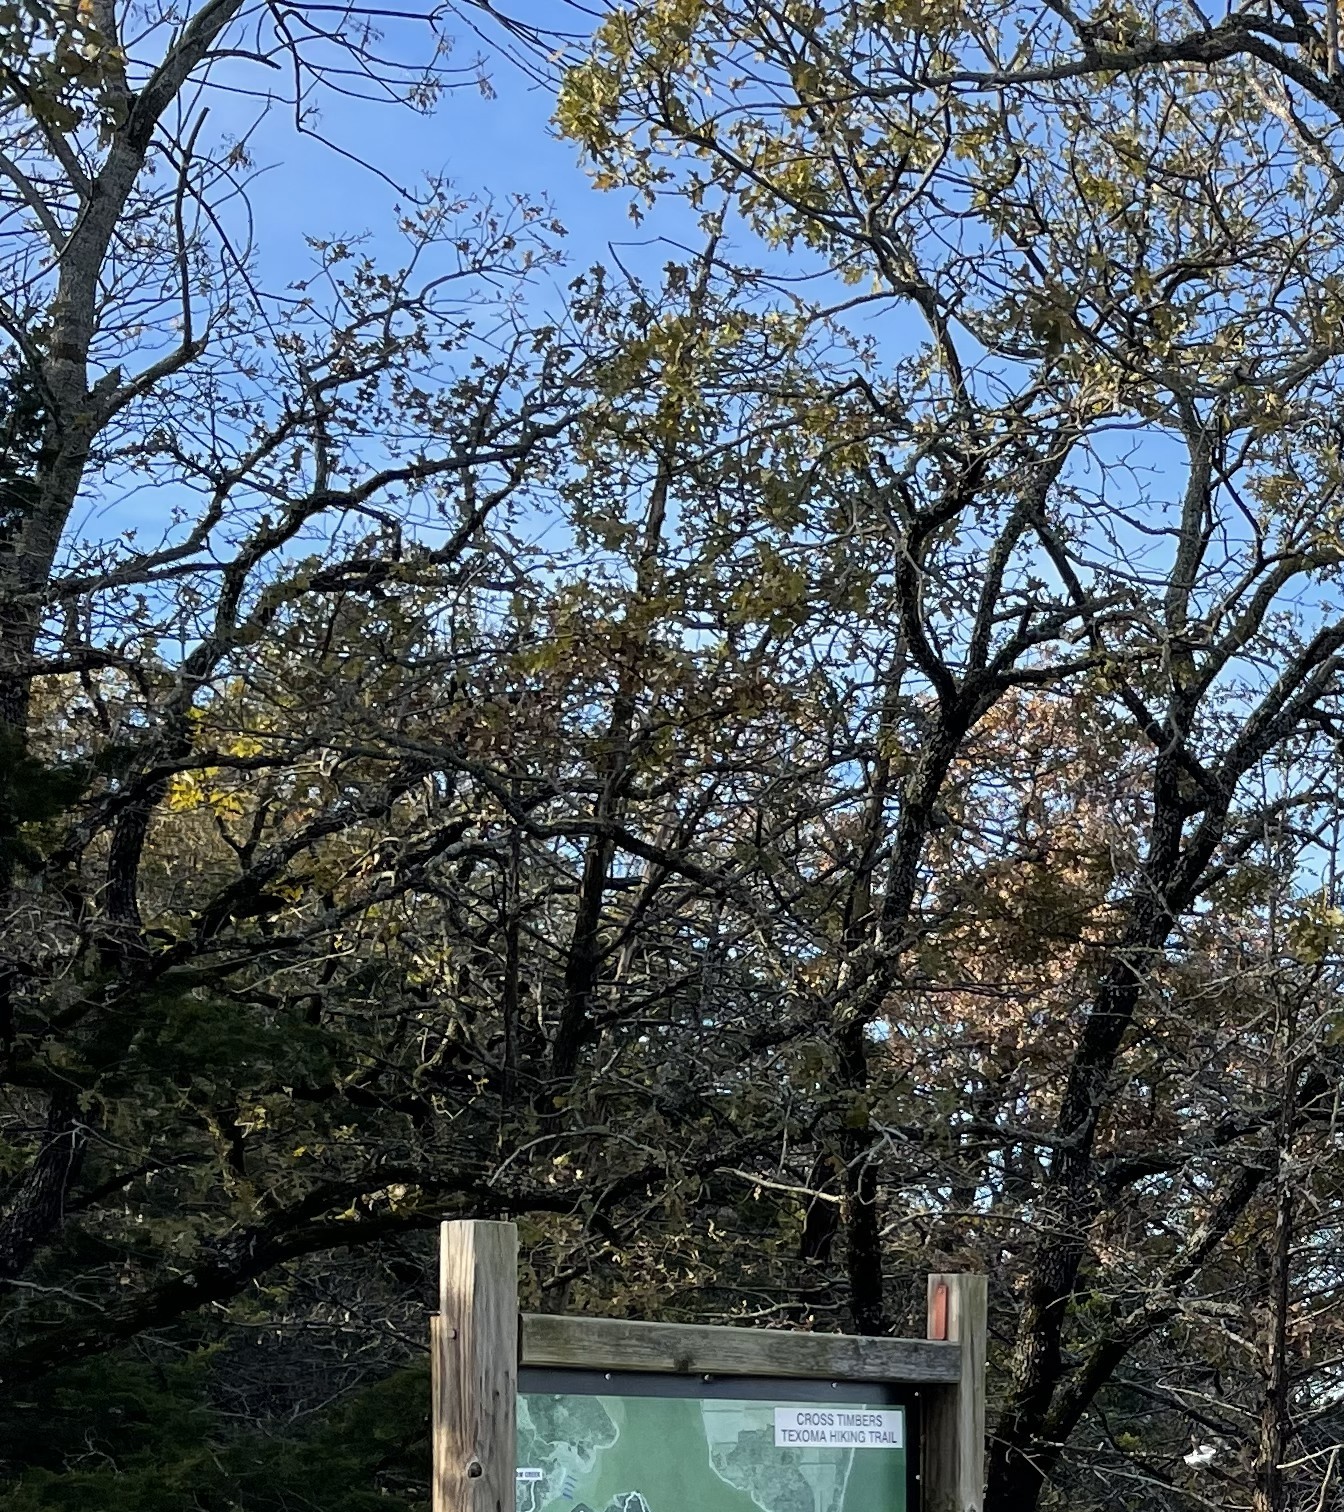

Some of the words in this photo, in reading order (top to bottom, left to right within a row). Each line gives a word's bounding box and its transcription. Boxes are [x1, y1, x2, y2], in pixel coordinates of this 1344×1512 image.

[797, 1412, 834, 1426] CROSS
[837, 1413, 883, 1427] TIMBERS
[781, 1429, 827, 1443] TEXOMA
[830, 1430, 866, 1444] HIKING
[868, 1431, 897, 1444] TRAIL
